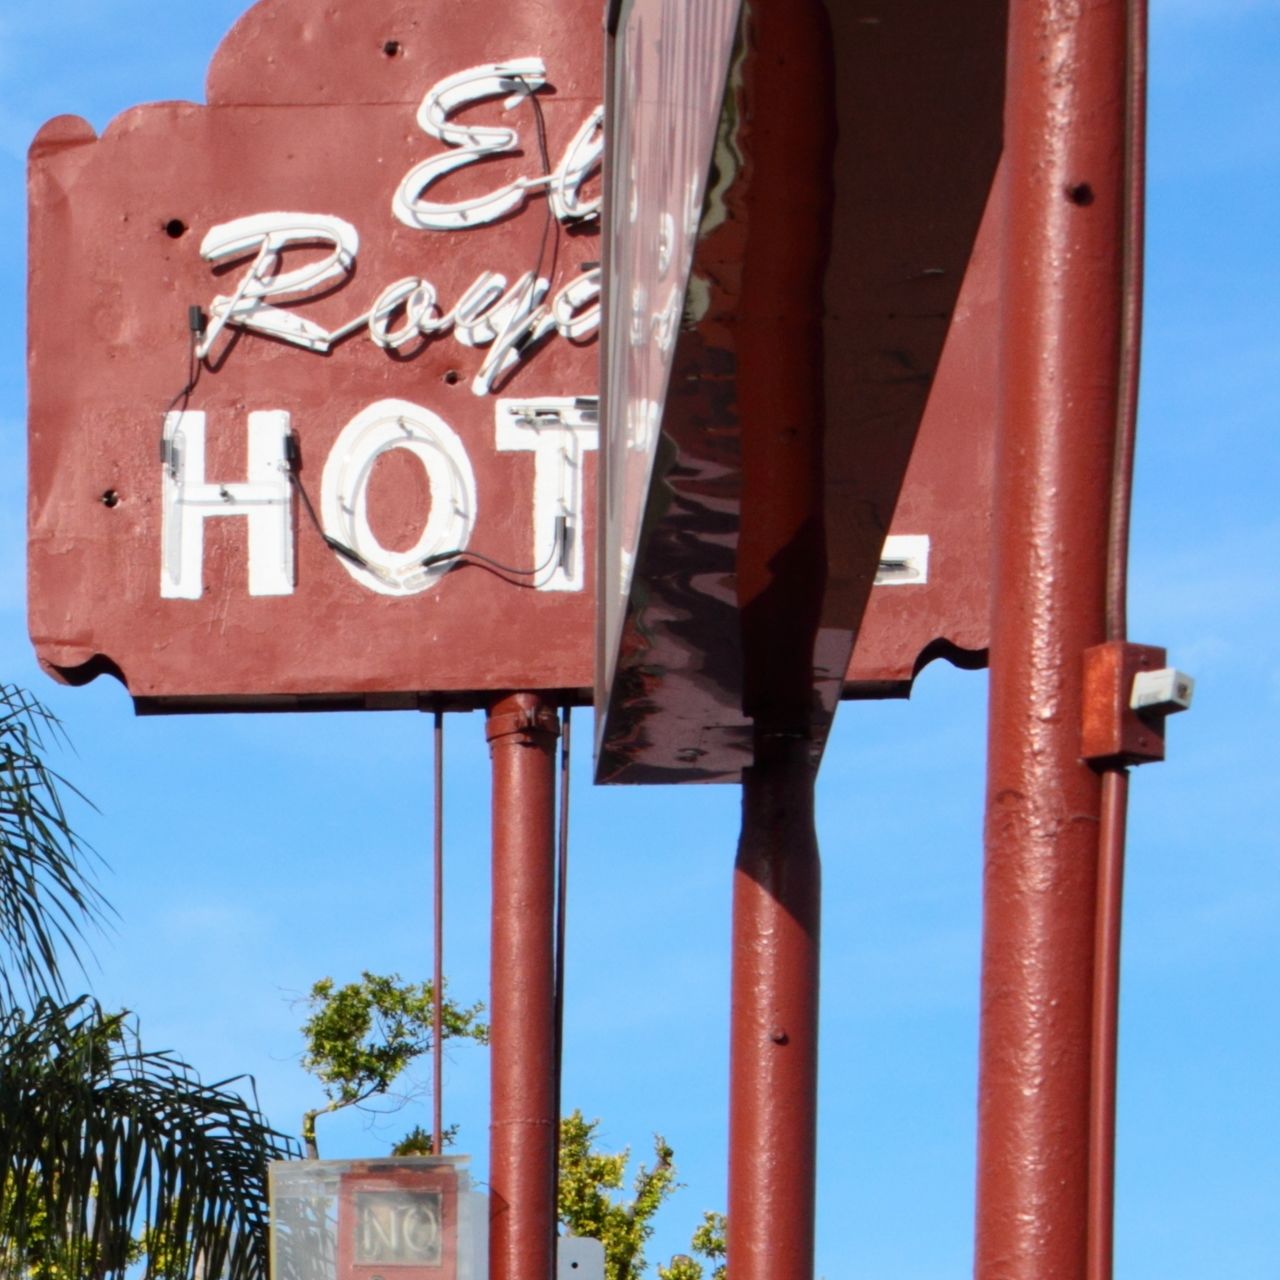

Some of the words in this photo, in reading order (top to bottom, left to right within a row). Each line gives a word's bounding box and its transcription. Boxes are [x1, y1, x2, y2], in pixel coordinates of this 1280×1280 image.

[391, 56, 604, 230] El
[199, 211, 602, 396] Roya
[362, 1203, 439, 1255] NO
